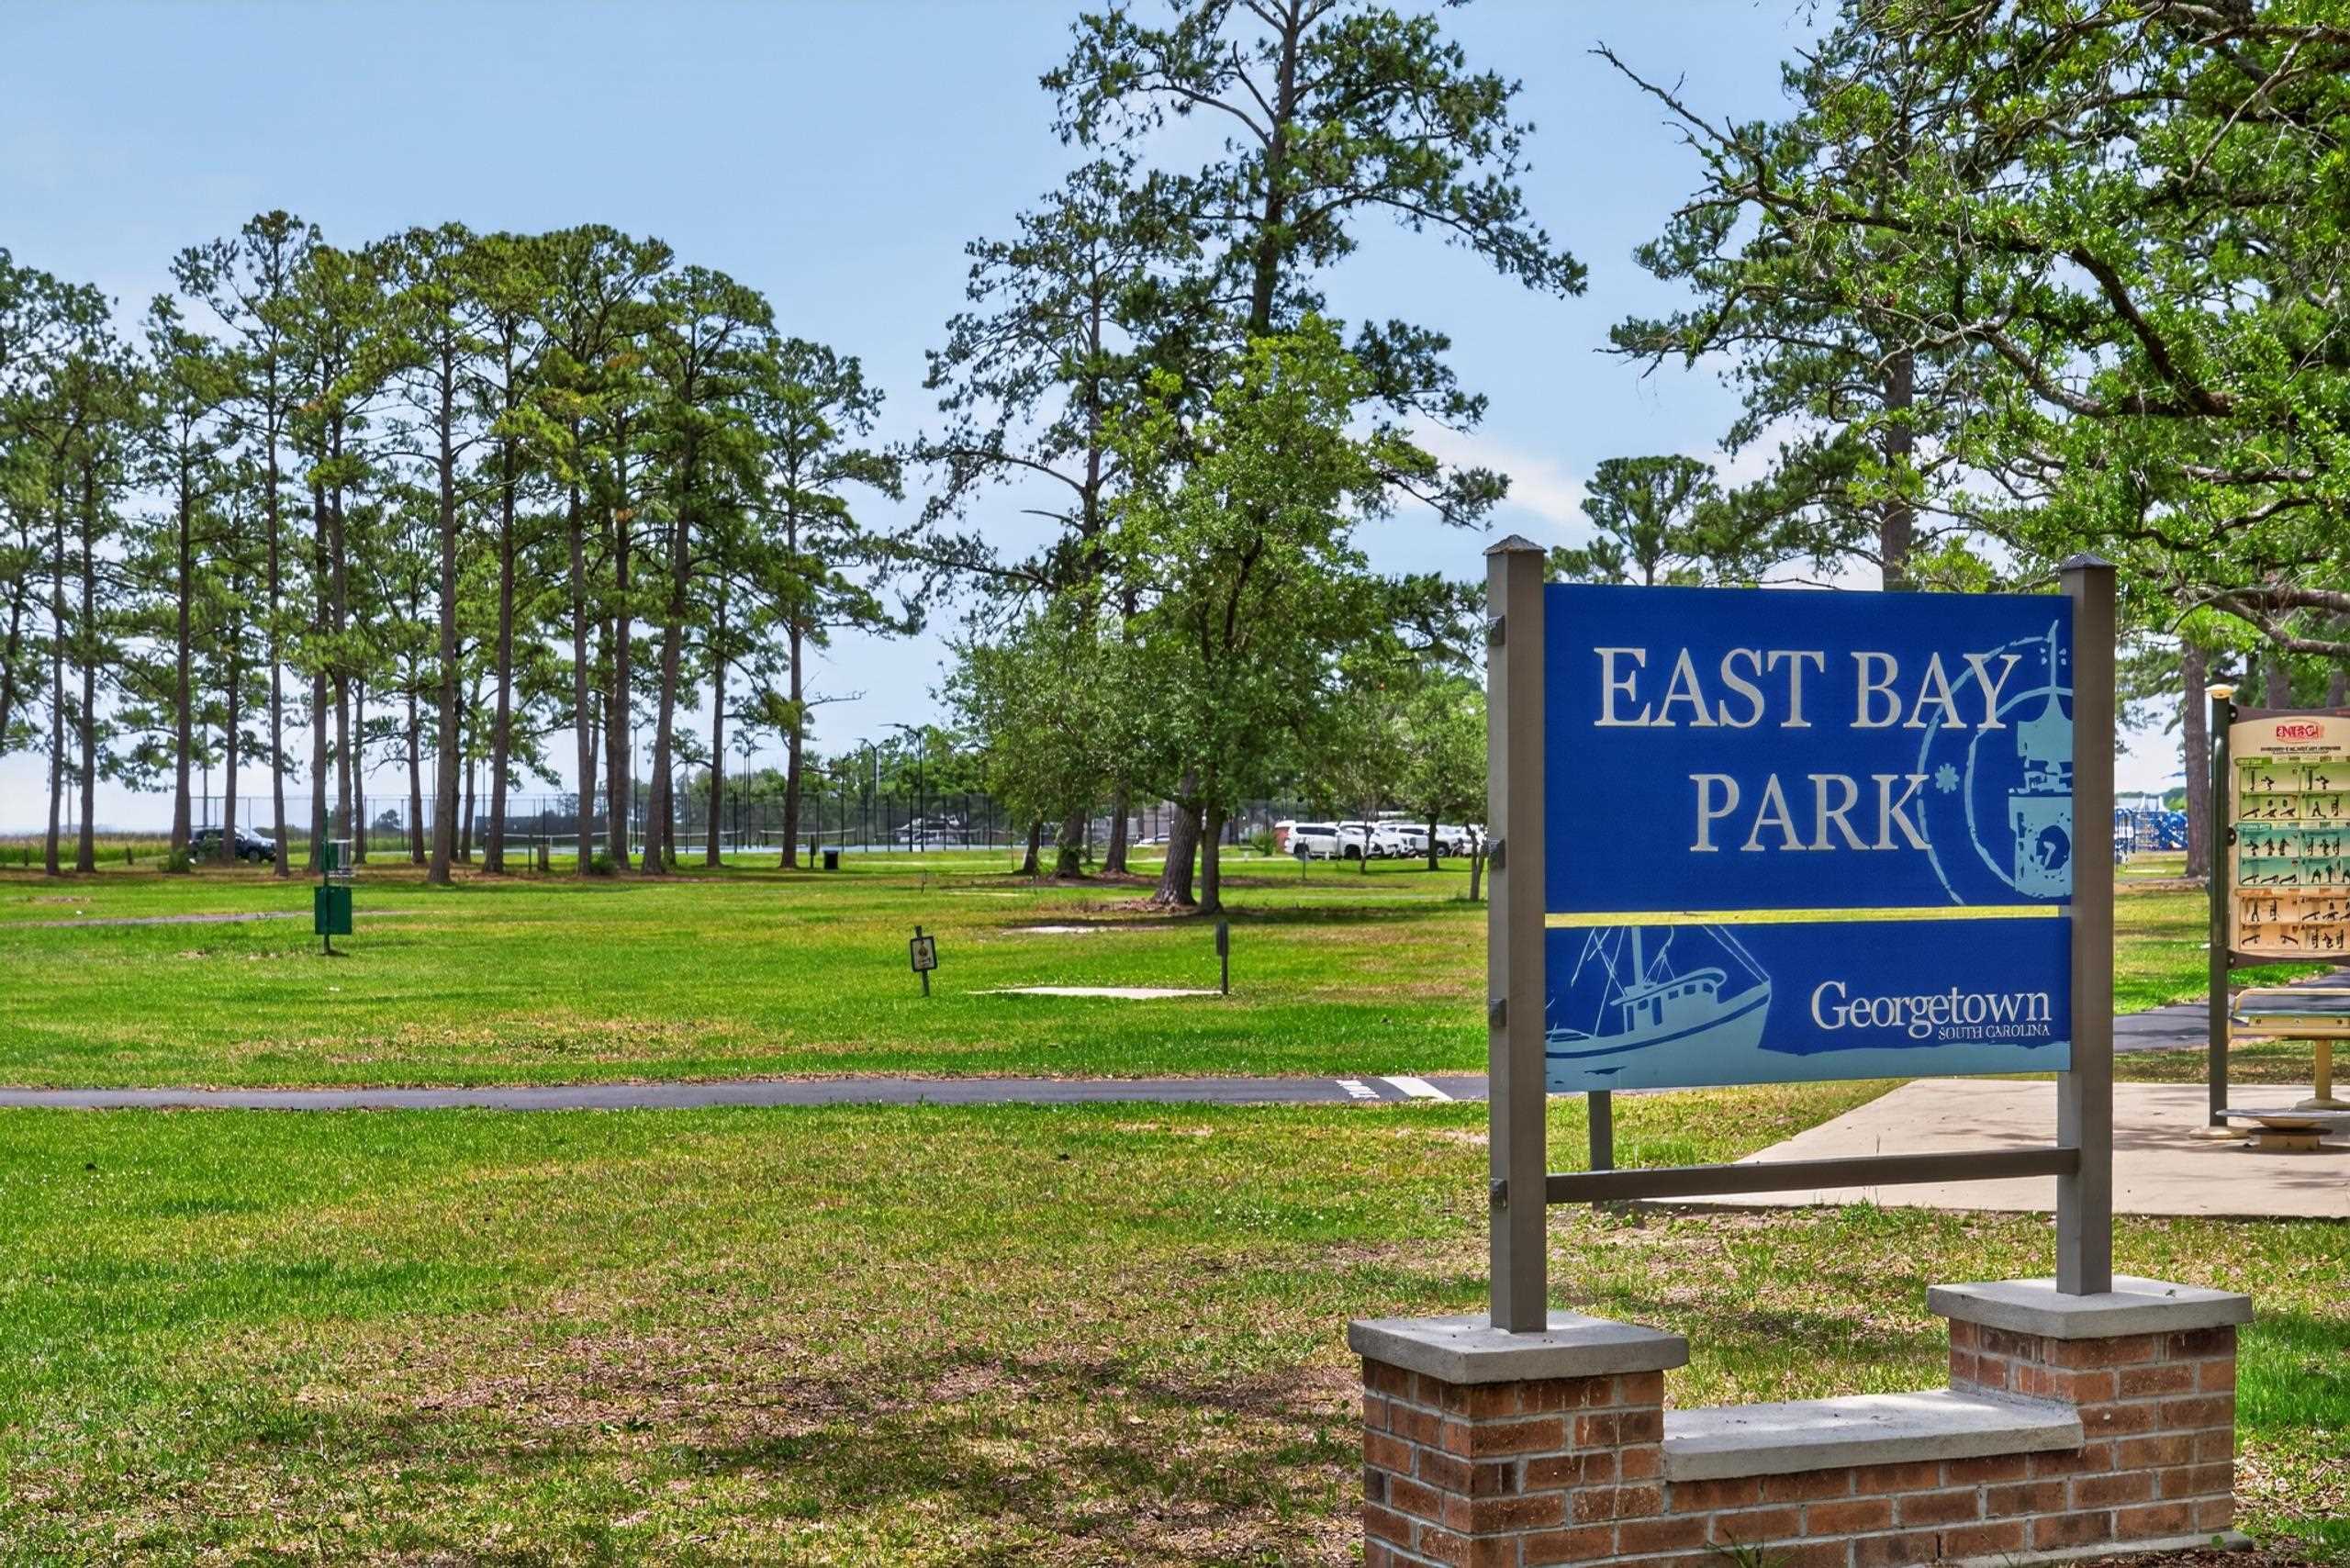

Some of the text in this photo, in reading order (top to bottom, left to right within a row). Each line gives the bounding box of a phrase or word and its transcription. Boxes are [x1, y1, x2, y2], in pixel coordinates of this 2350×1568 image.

[1594, 647, 2022, 729] EAST BAY
[1689, 773, 1933, 852] PARK
[1811, 980, 2053, 1039] Georgetown
[1939, 1024, 2051, 1040] SOUTH CAROLINA
